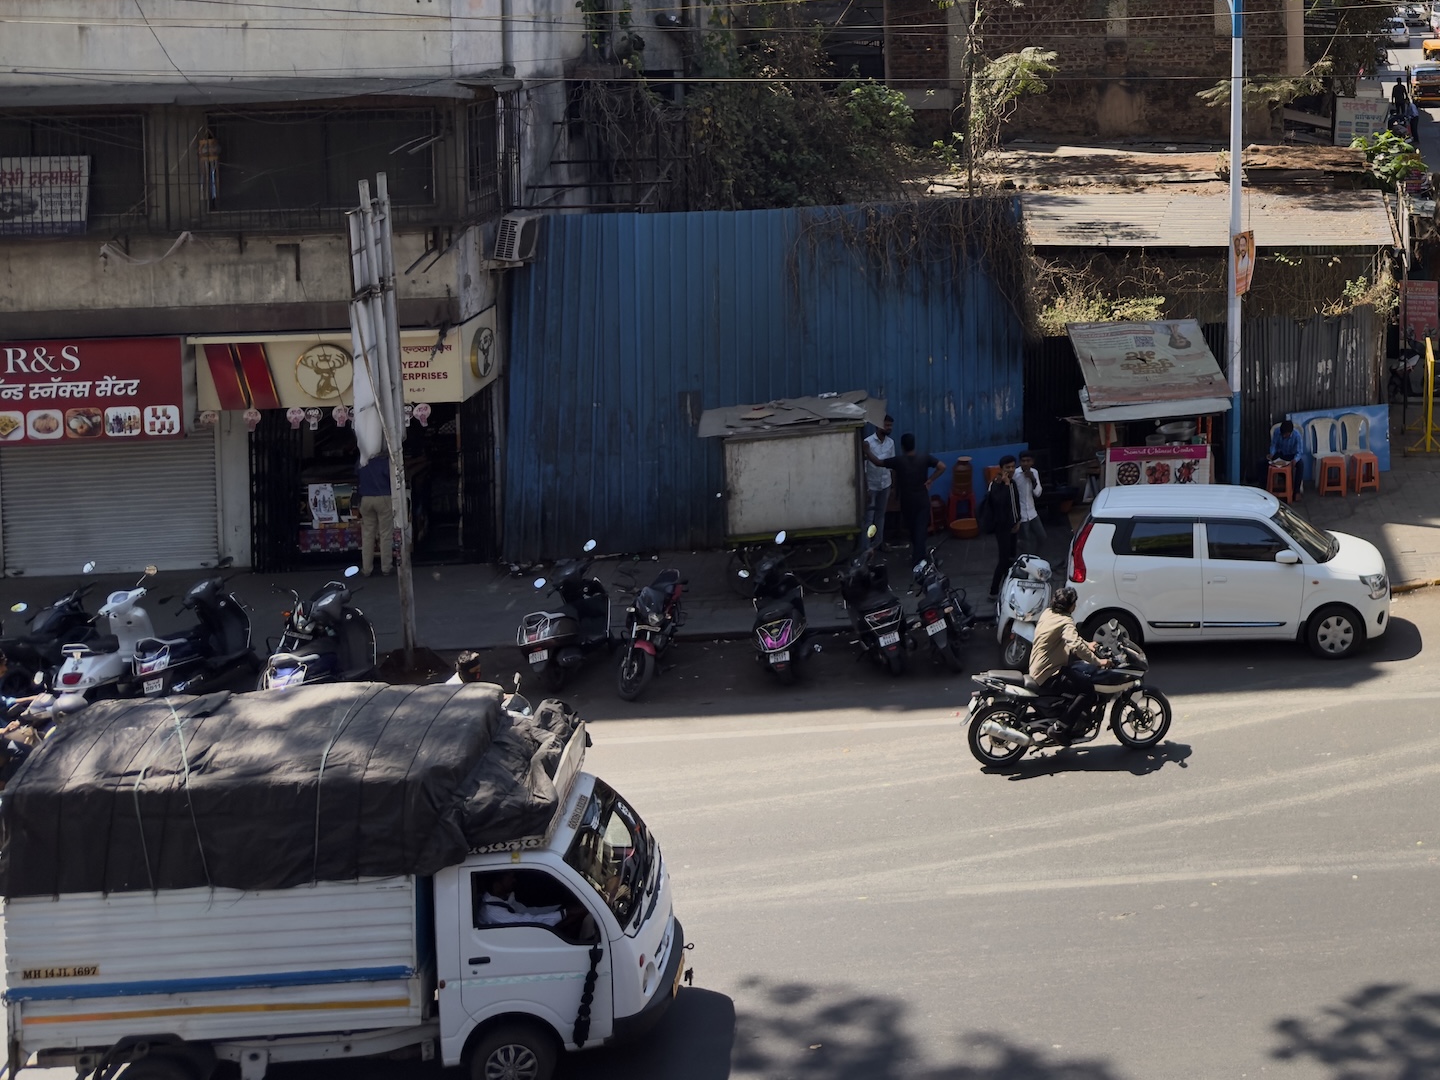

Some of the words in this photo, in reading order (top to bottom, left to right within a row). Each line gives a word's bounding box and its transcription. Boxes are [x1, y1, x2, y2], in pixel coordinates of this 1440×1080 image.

[2, 345, 81, 374] R&S
[402, 361, 429, 369] YEZDI
[29, 376, 93, 400] स्नॅक्स
[95, 375, 141, 398] सेंटर
[23, 969, 41, 980] MH
[44, 968, 54, 978] 14
[56, 968, 70, 978] JL
